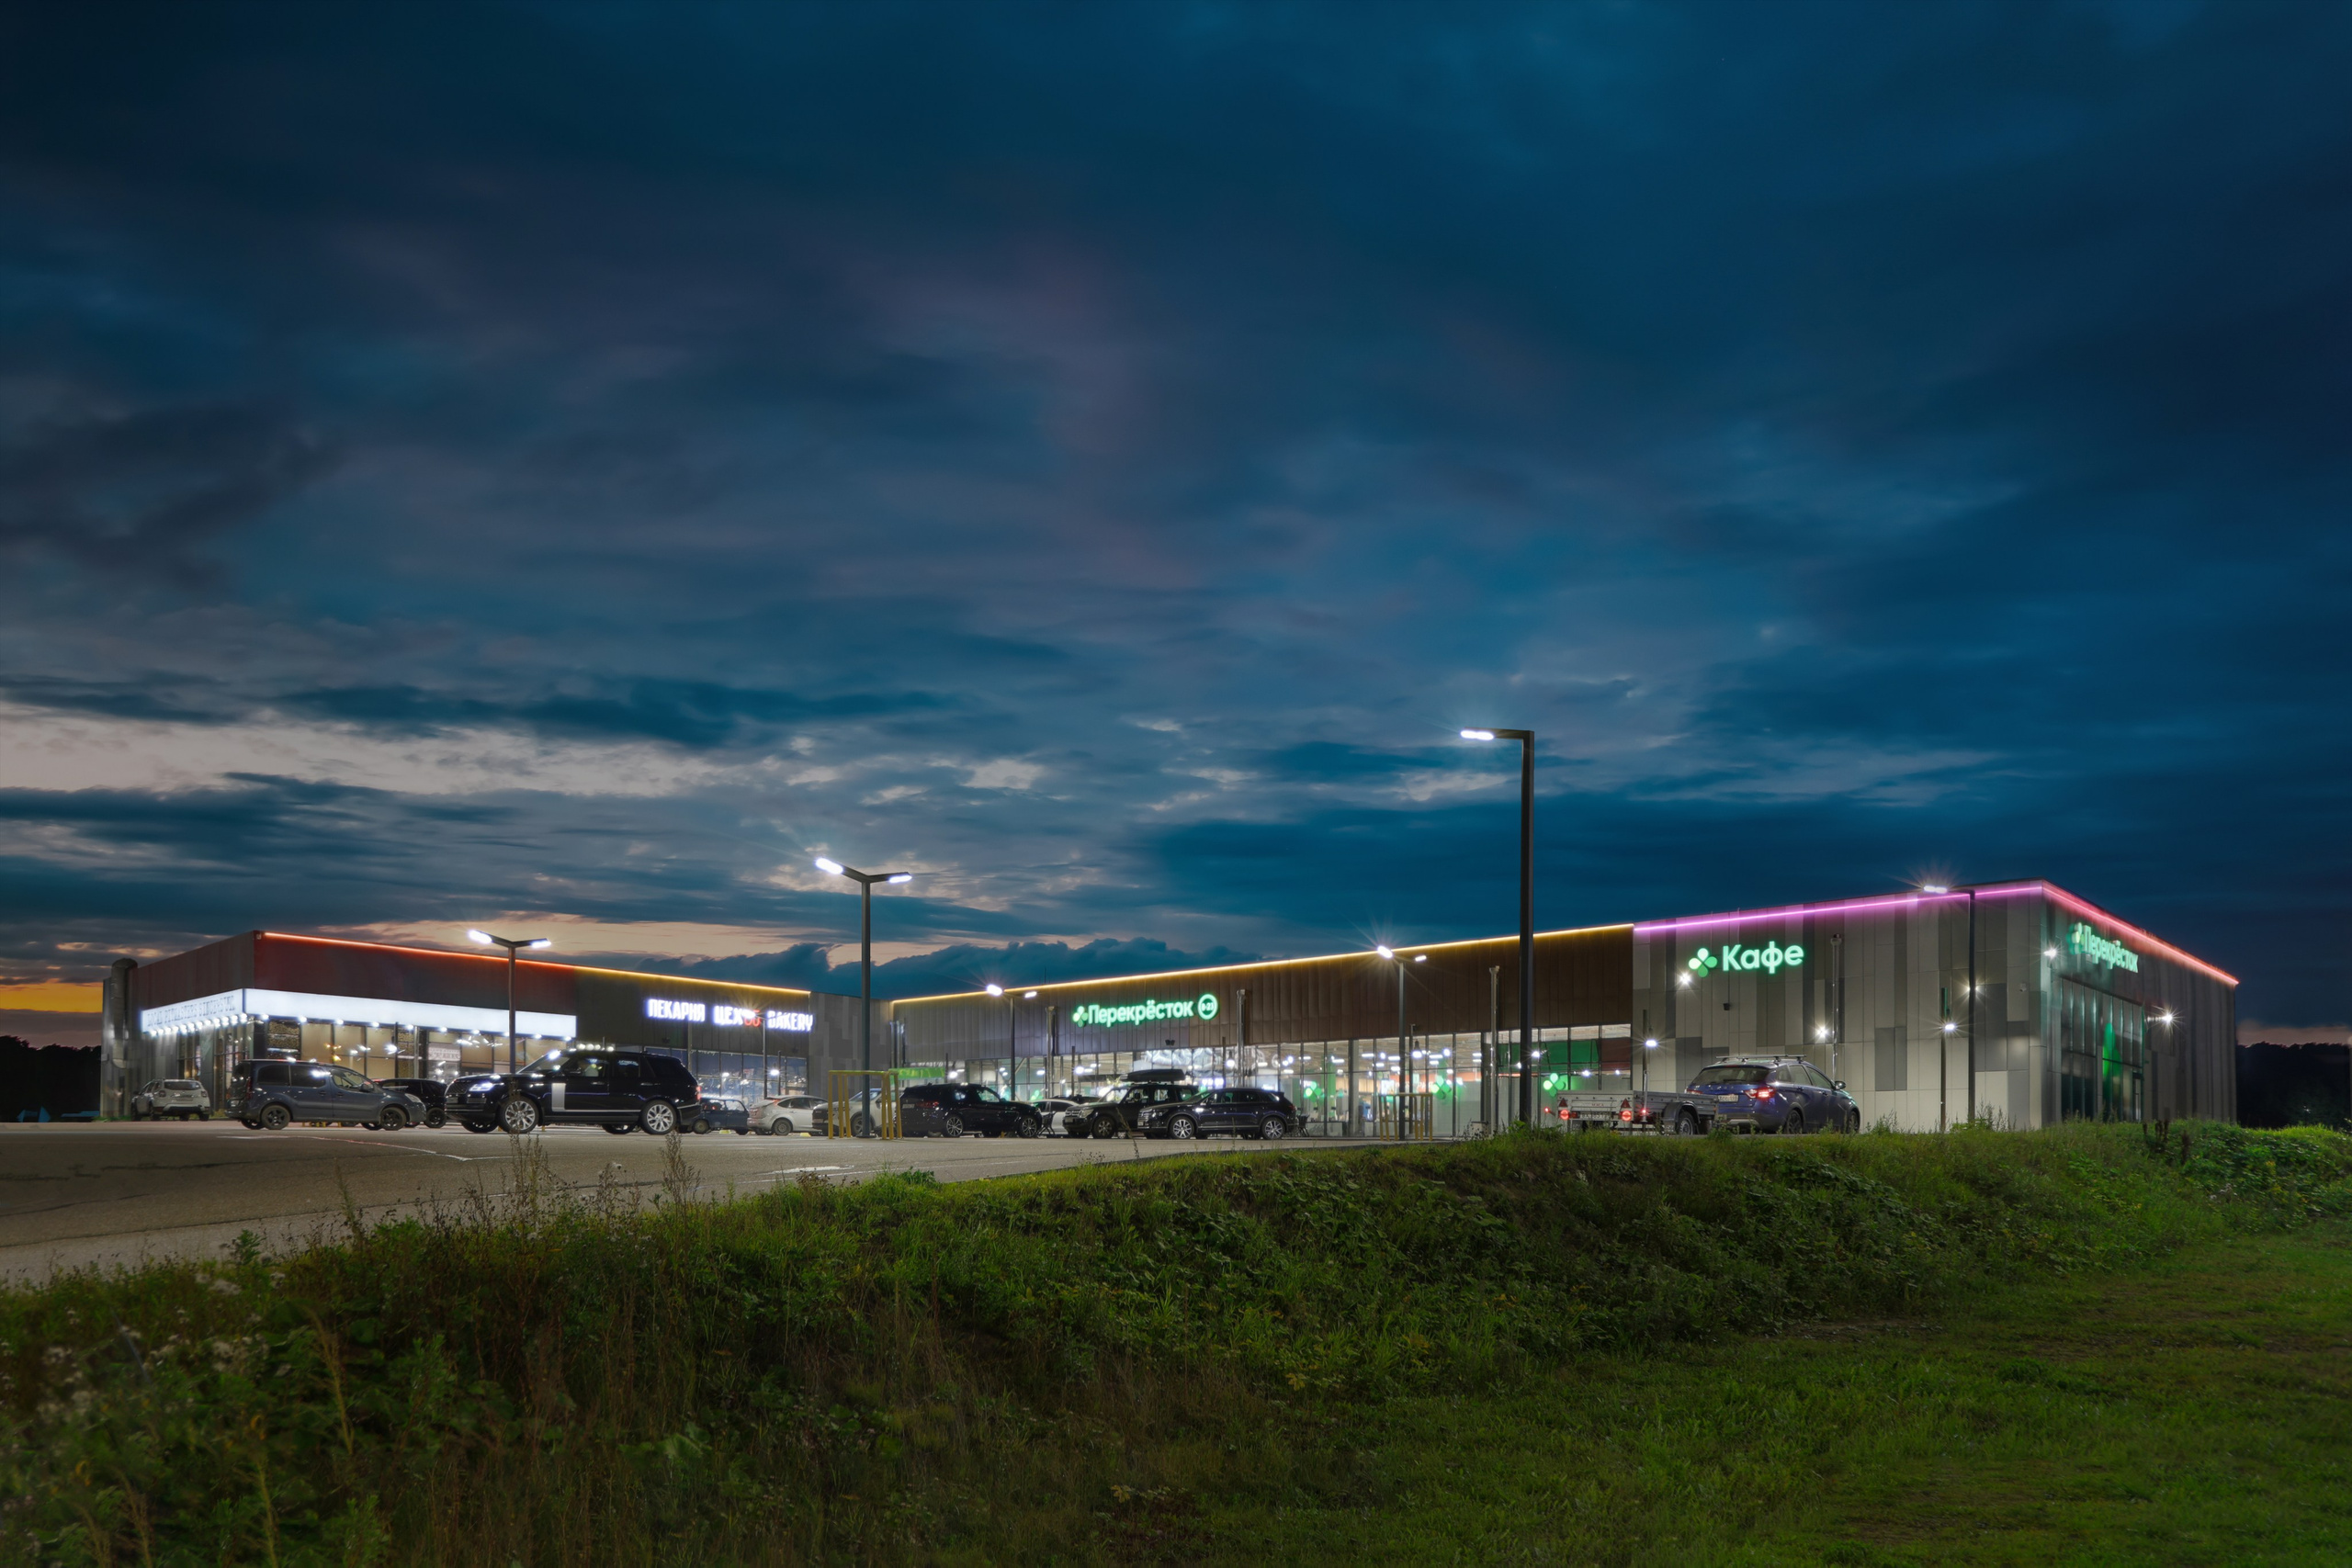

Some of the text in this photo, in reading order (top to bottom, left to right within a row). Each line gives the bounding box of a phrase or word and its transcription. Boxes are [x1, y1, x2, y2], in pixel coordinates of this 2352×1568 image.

[1723, 941, 1804, 974] Кафе
[2084, 925, 2138, 973] Перекрёсток
[647, 998, 706, 1022] ПЕКАРНЯ
[766, 1010, 813, 1032] BAKERY
[1088, 999, 1194, 1028] Перекрёсток
